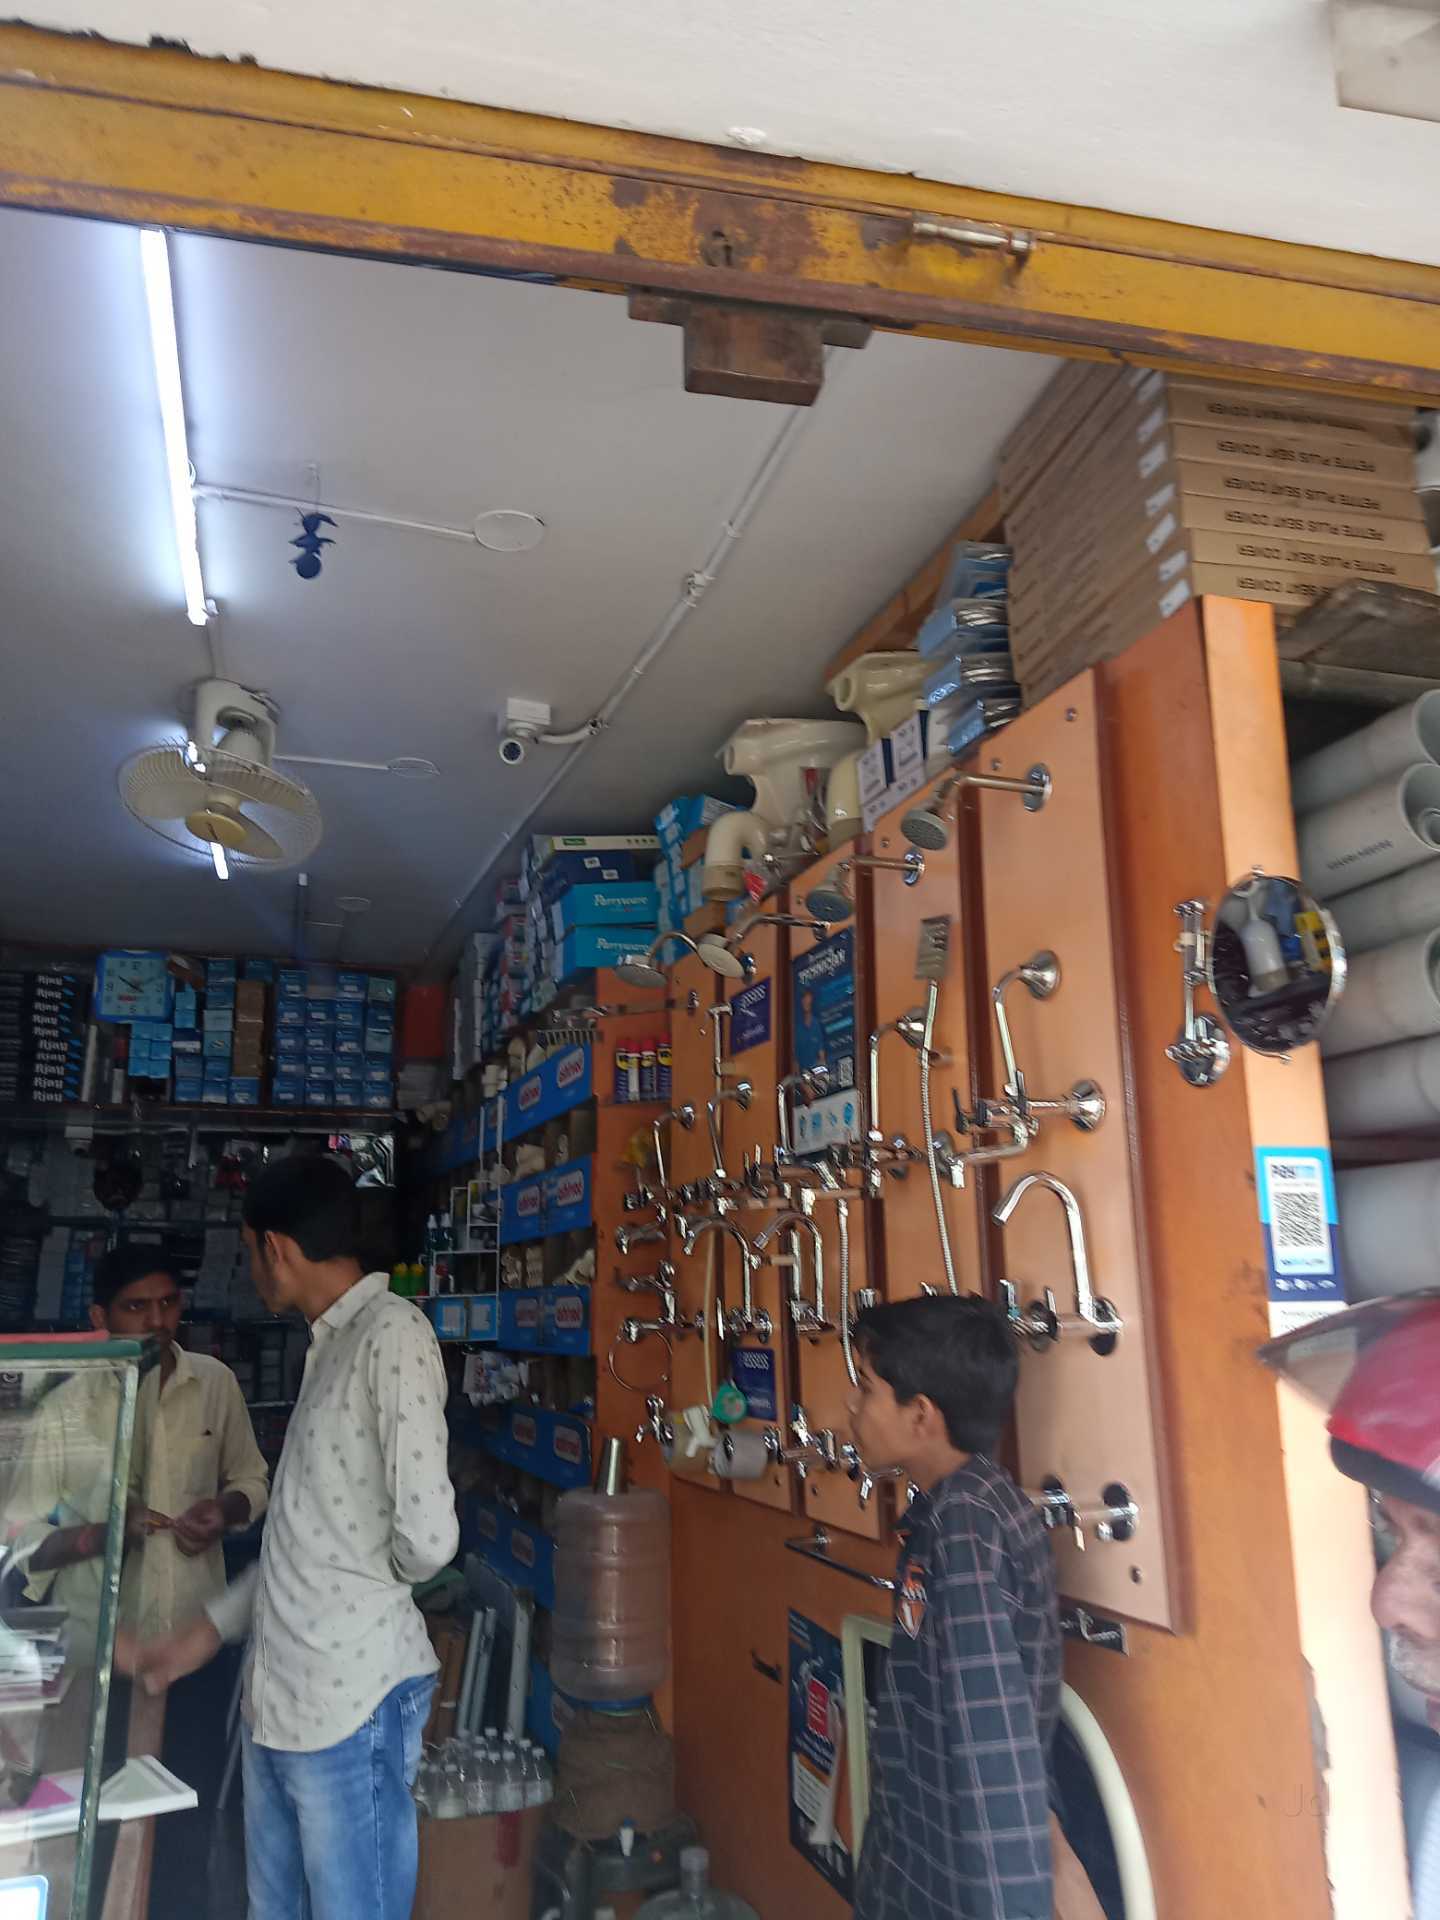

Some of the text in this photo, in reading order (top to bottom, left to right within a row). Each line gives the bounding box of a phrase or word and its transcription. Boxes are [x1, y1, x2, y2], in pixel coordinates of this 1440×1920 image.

[1216, 440, 1261, 457] COVER
[1223, 478, 1267, 494] COVER
[1272, 485, 1301, 498] SEAT
[1224, 511, 1268, 526] COVER
[1273, 517, 1303, 531] SEAT
[1308, 520, 1338, 535] PLUS
[1237, 544, 1281, 560] COVER
[1286, 551, 1316, 565] SEAT
[1320, 555, 1351, 570] PLUS
[1236, 577, 1281, 592] COVER
